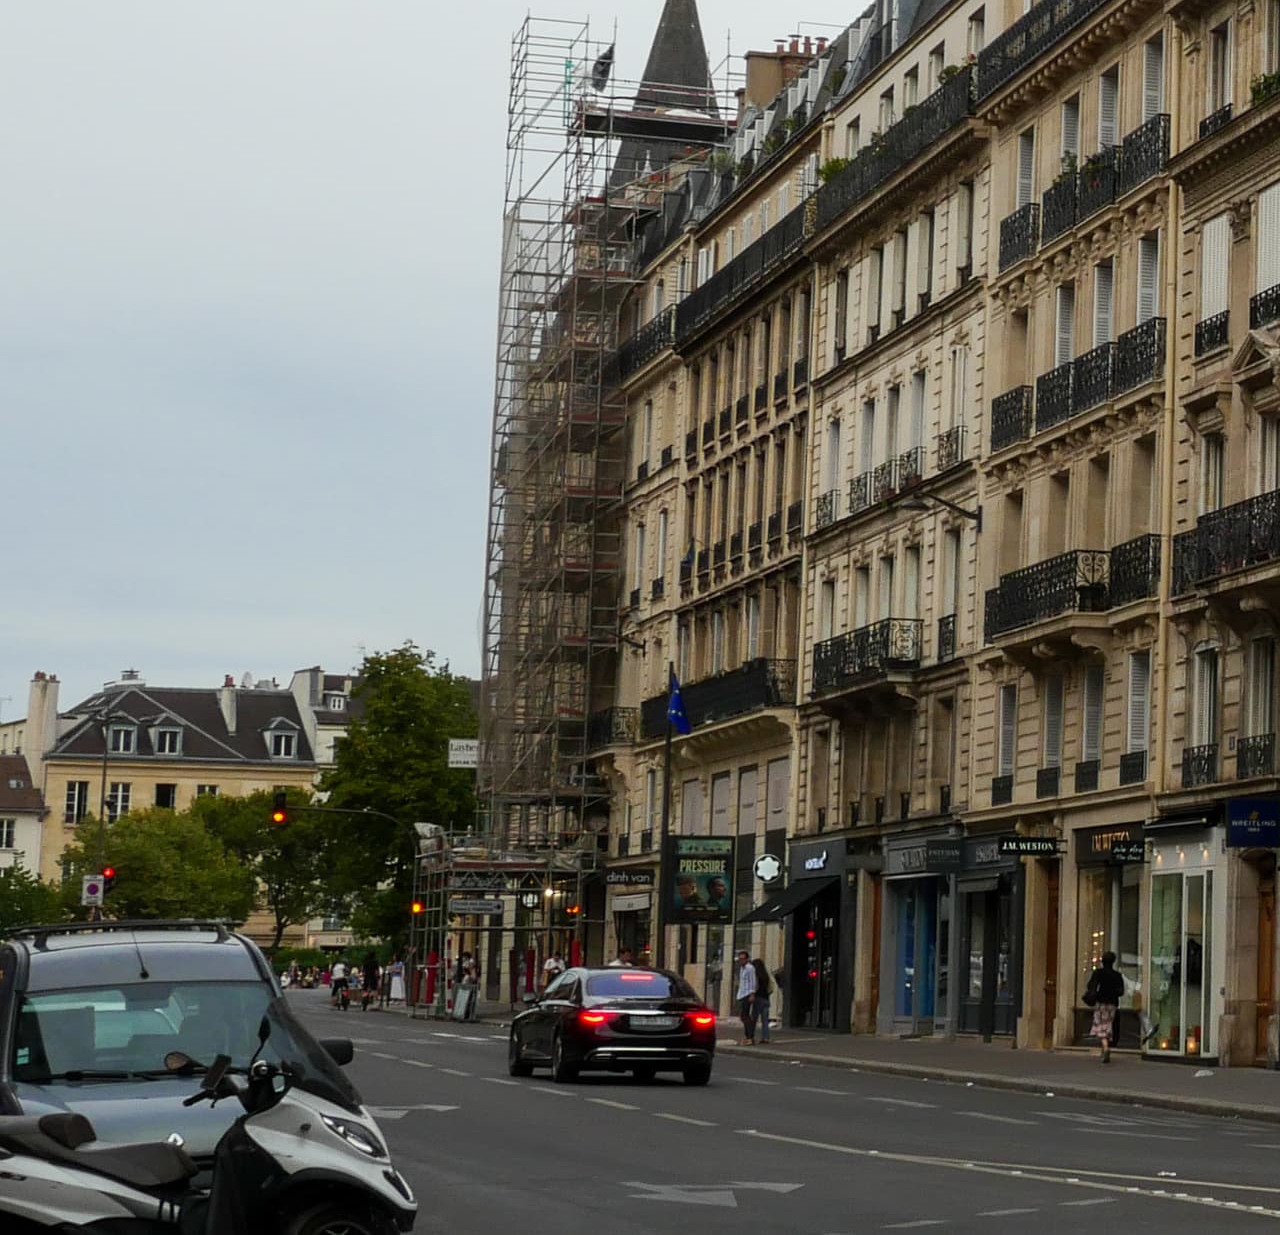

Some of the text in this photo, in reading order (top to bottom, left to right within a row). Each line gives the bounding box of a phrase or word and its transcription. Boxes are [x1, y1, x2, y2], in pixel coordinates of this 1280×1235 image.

[1231, 819, 1277, 827] BREITLING
[1018, 839, 1054, 850] WESTON
[679, 859, 727, 873] PRESSURE
[606, 873, 649, 883] dinh van
